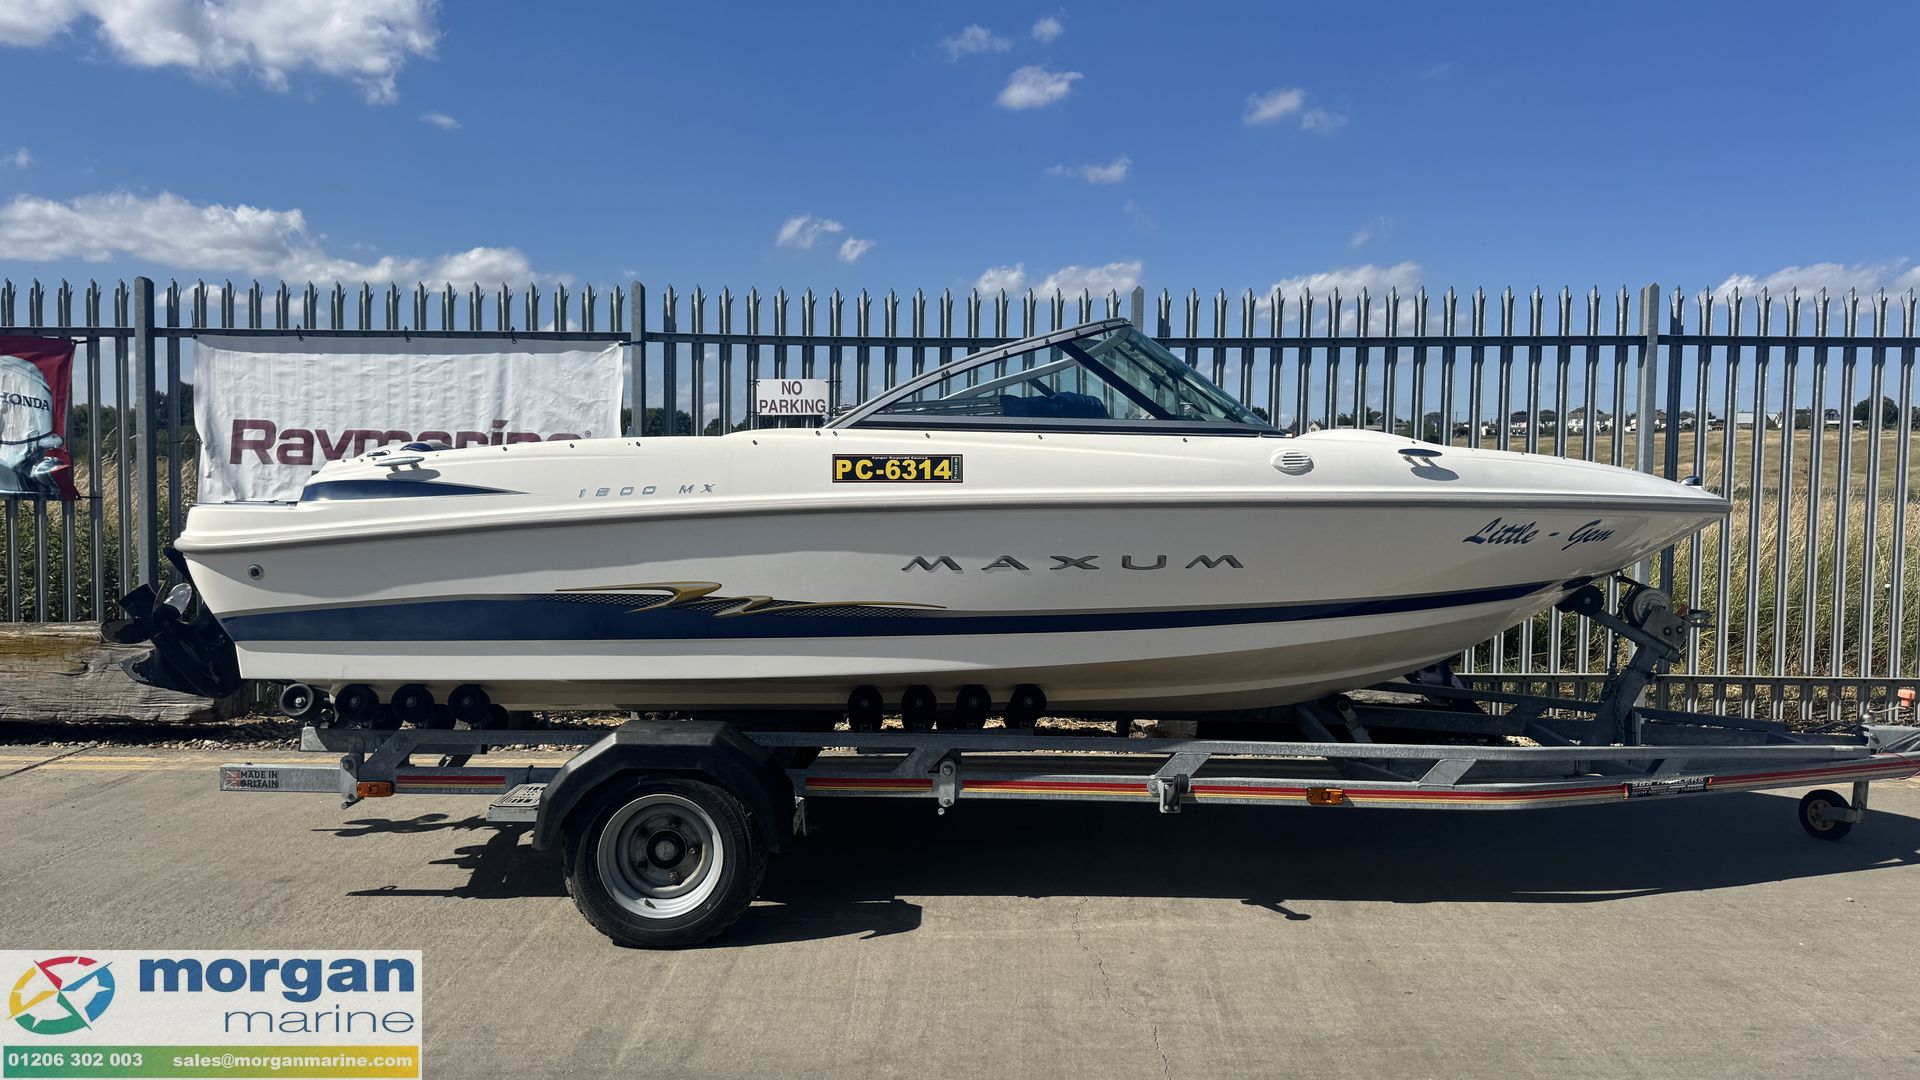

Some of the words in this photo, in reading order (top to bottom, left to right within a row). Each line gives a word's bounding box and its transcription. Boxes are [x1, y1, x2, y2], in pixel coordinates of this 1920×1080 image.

[782, 381, 803, 395] NO
[759, 399, 826, 414] PARKING
[836, 459, 952, 480] PC-6314
[678, 483, 717, 494] MX
[1462, 517, 1540, 545] Little
[1561, 519, 1616, 551] Gem
[901, 554, 1244, 571] MAXUM
[240, 770, 266, 779] MADE
[268, 770, 278, 779] IN
[240, 779, 279, 788] BRITAIN
